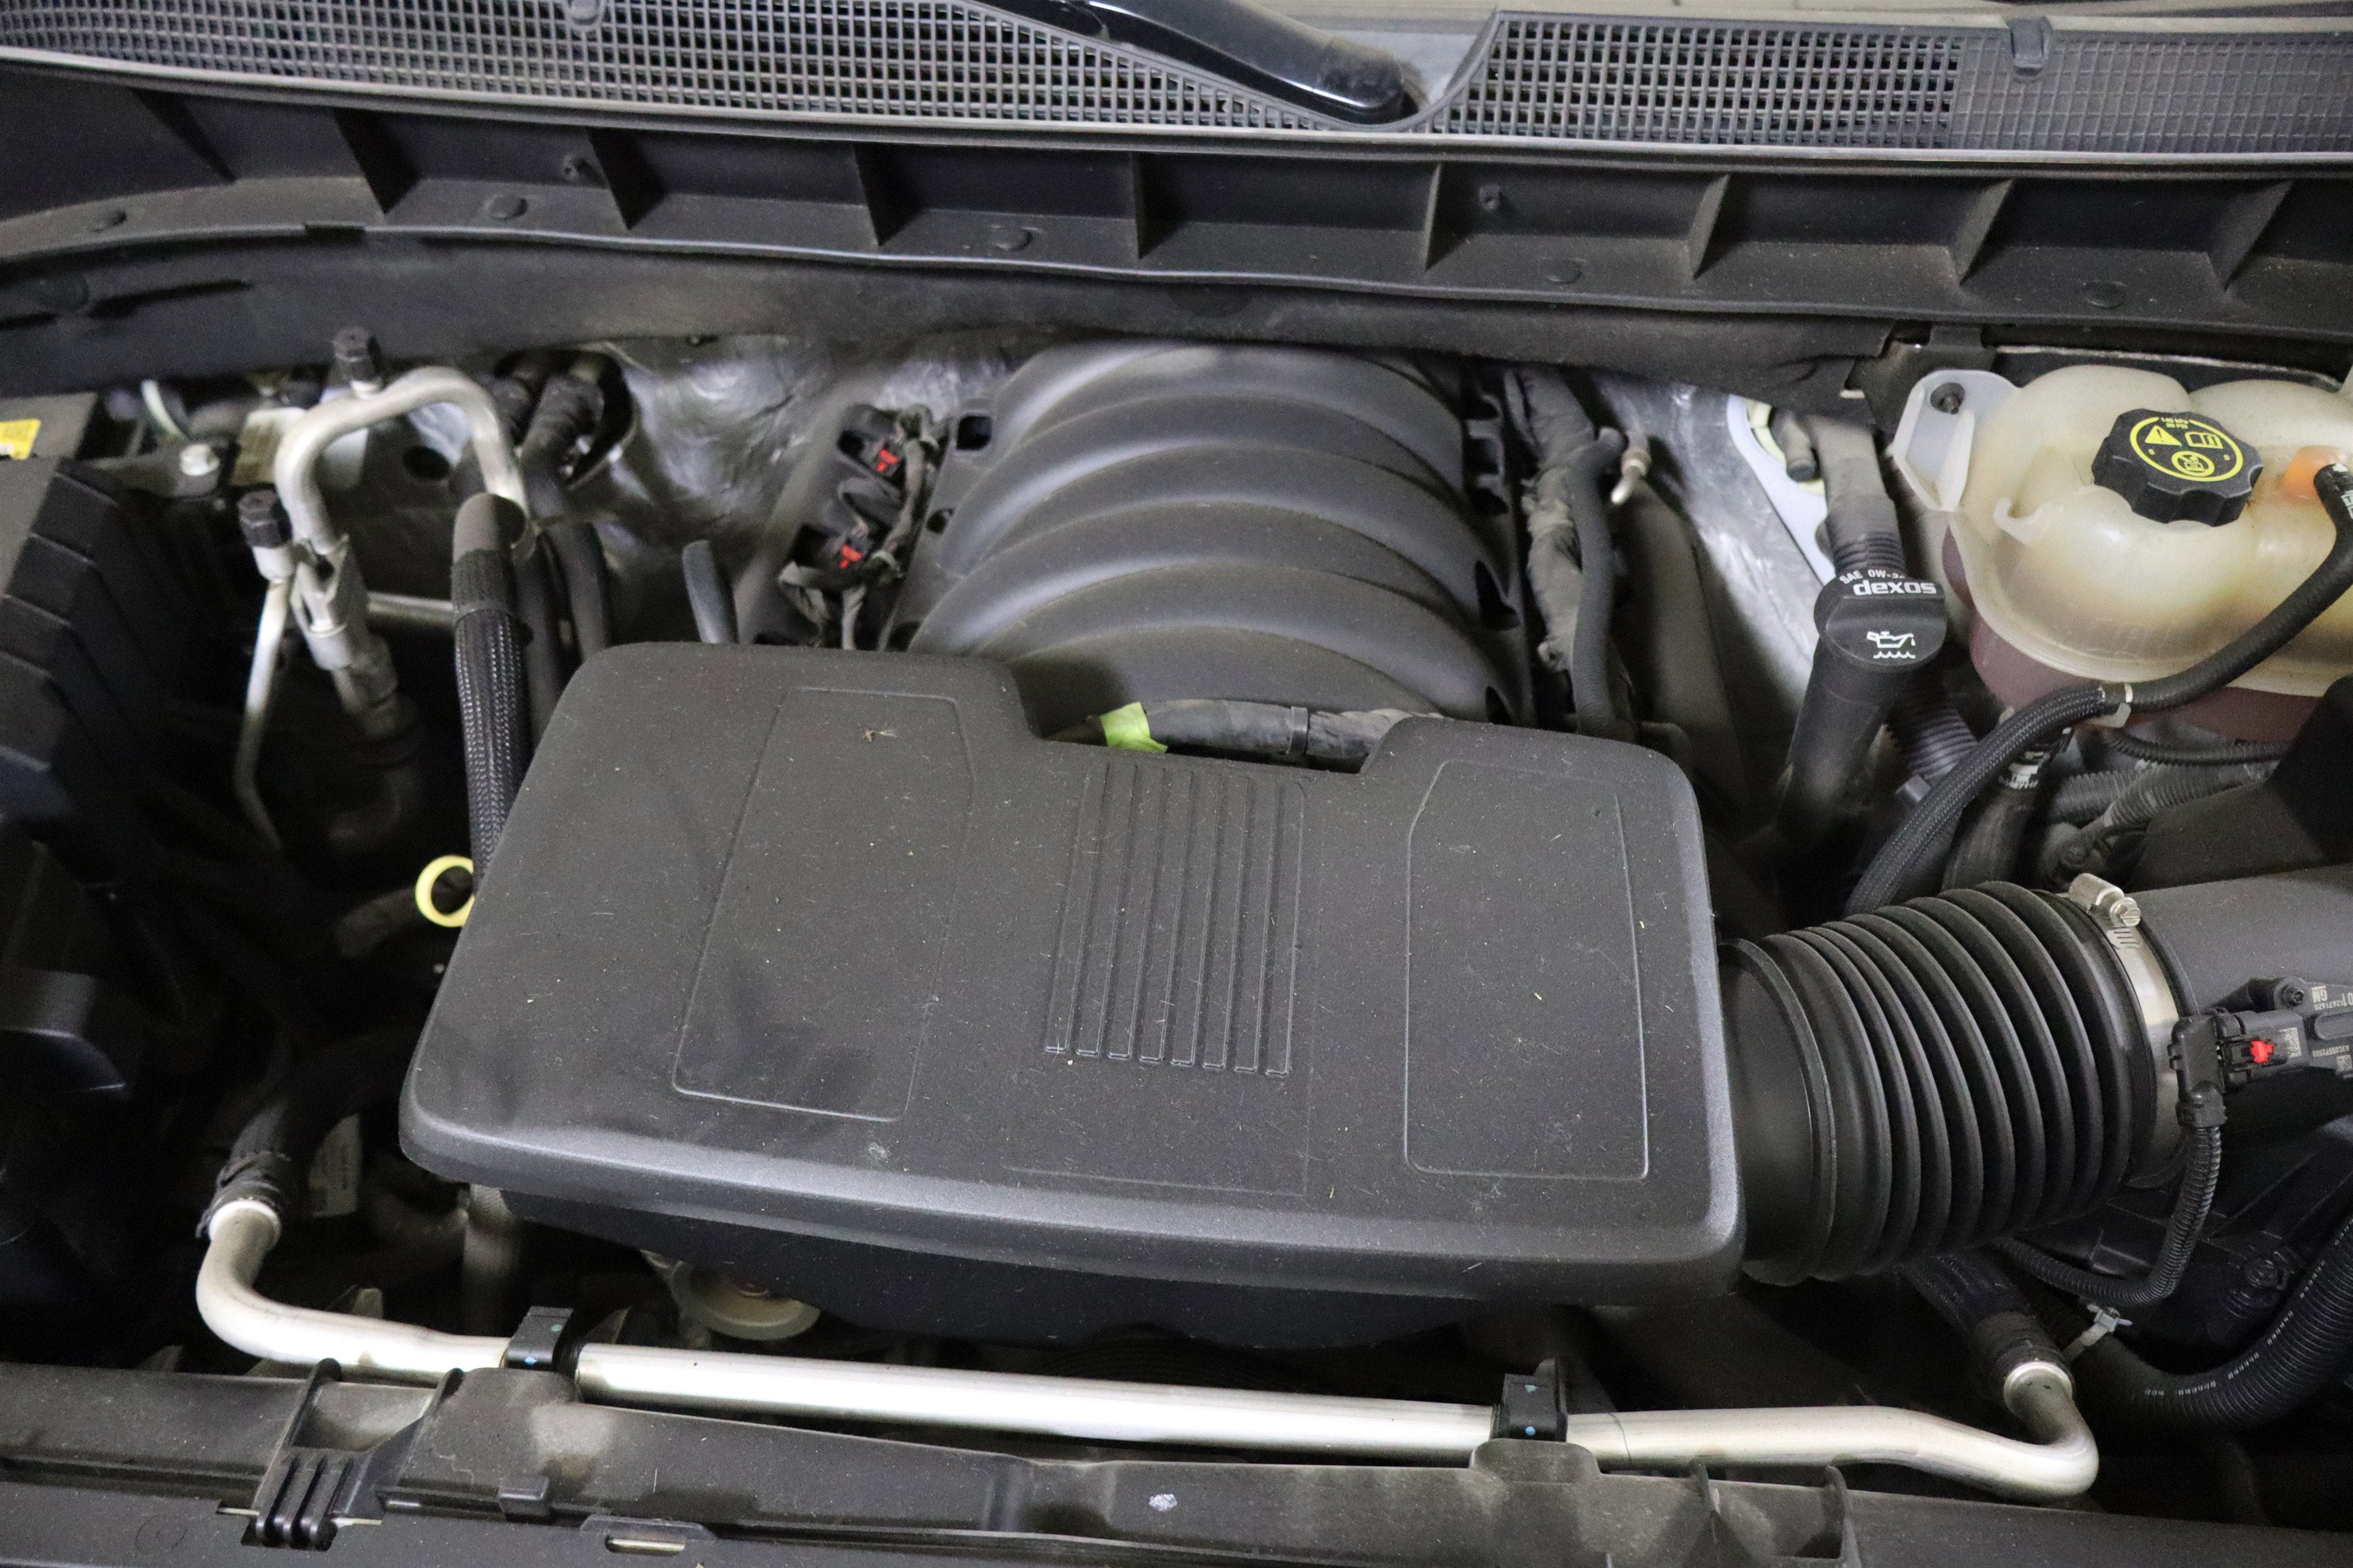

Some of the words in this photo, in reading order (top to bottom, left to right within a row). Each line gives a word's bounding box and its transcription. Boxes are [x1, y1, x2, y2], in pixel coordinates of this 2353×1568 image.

[1839, 570, 1863, 584] SAE
[1853, 580, 1937, 596] dexos
[2312, 987, 2328, 1003] GM
